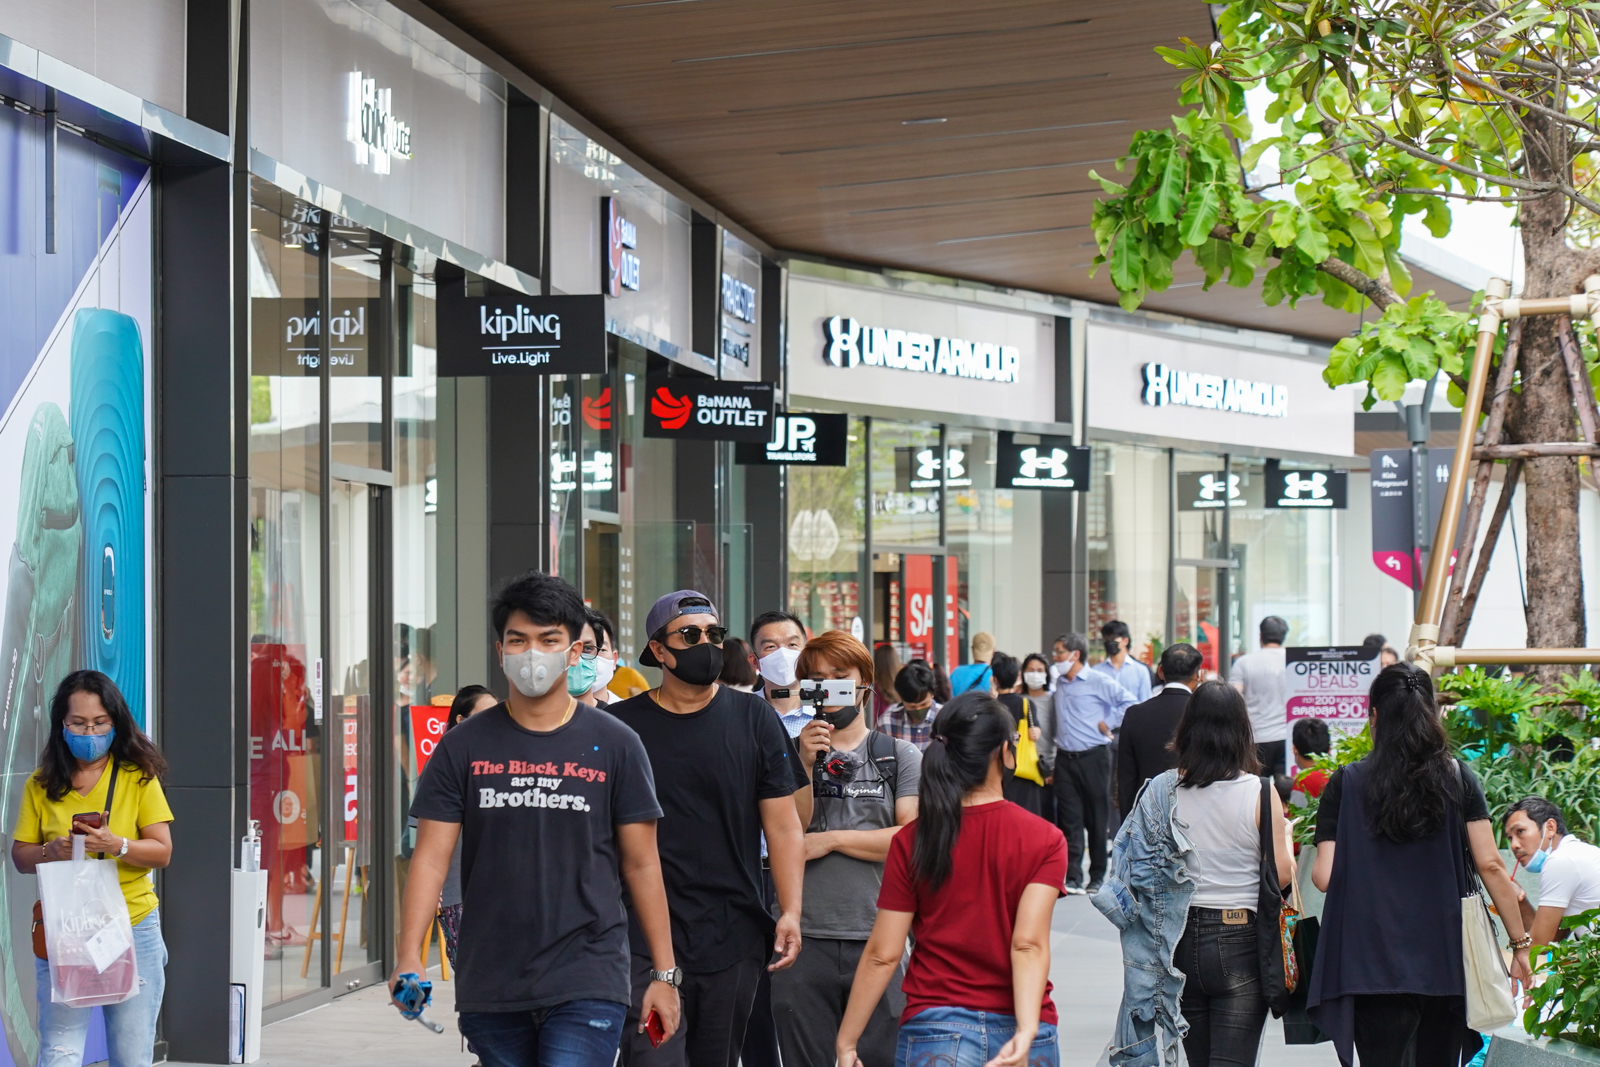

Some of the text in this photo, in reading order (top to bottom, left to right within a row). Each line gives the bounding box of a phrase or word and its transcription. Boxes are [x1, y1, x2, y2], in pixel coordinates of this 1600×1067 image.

[480, 304, 560, 341] kipling
[492, 351, 550, 366] Live.Light
[862, 325, 1020, 383] UNDER ARMOUR
[697, 395, 751, 408] BaNANA
[1169, 369, 1288, 418] UNDER ARMOUR
[697, 409, 767, 426] OUTLET
[766, 416, 816, 451] JP
[1372, 480, 1408, 488] Playground
[910, 593, 955, 637] SAE
[1295, 662, 1371, 675] OPENING
[1308, 675, 1359, 689] DEALS
[1315, 696, 1336, 705] 200
[471, 760, 607, 783] The Black Keys
[510, 776, 563, 791] are my
[479, 788, 591, 813] Brothers.
